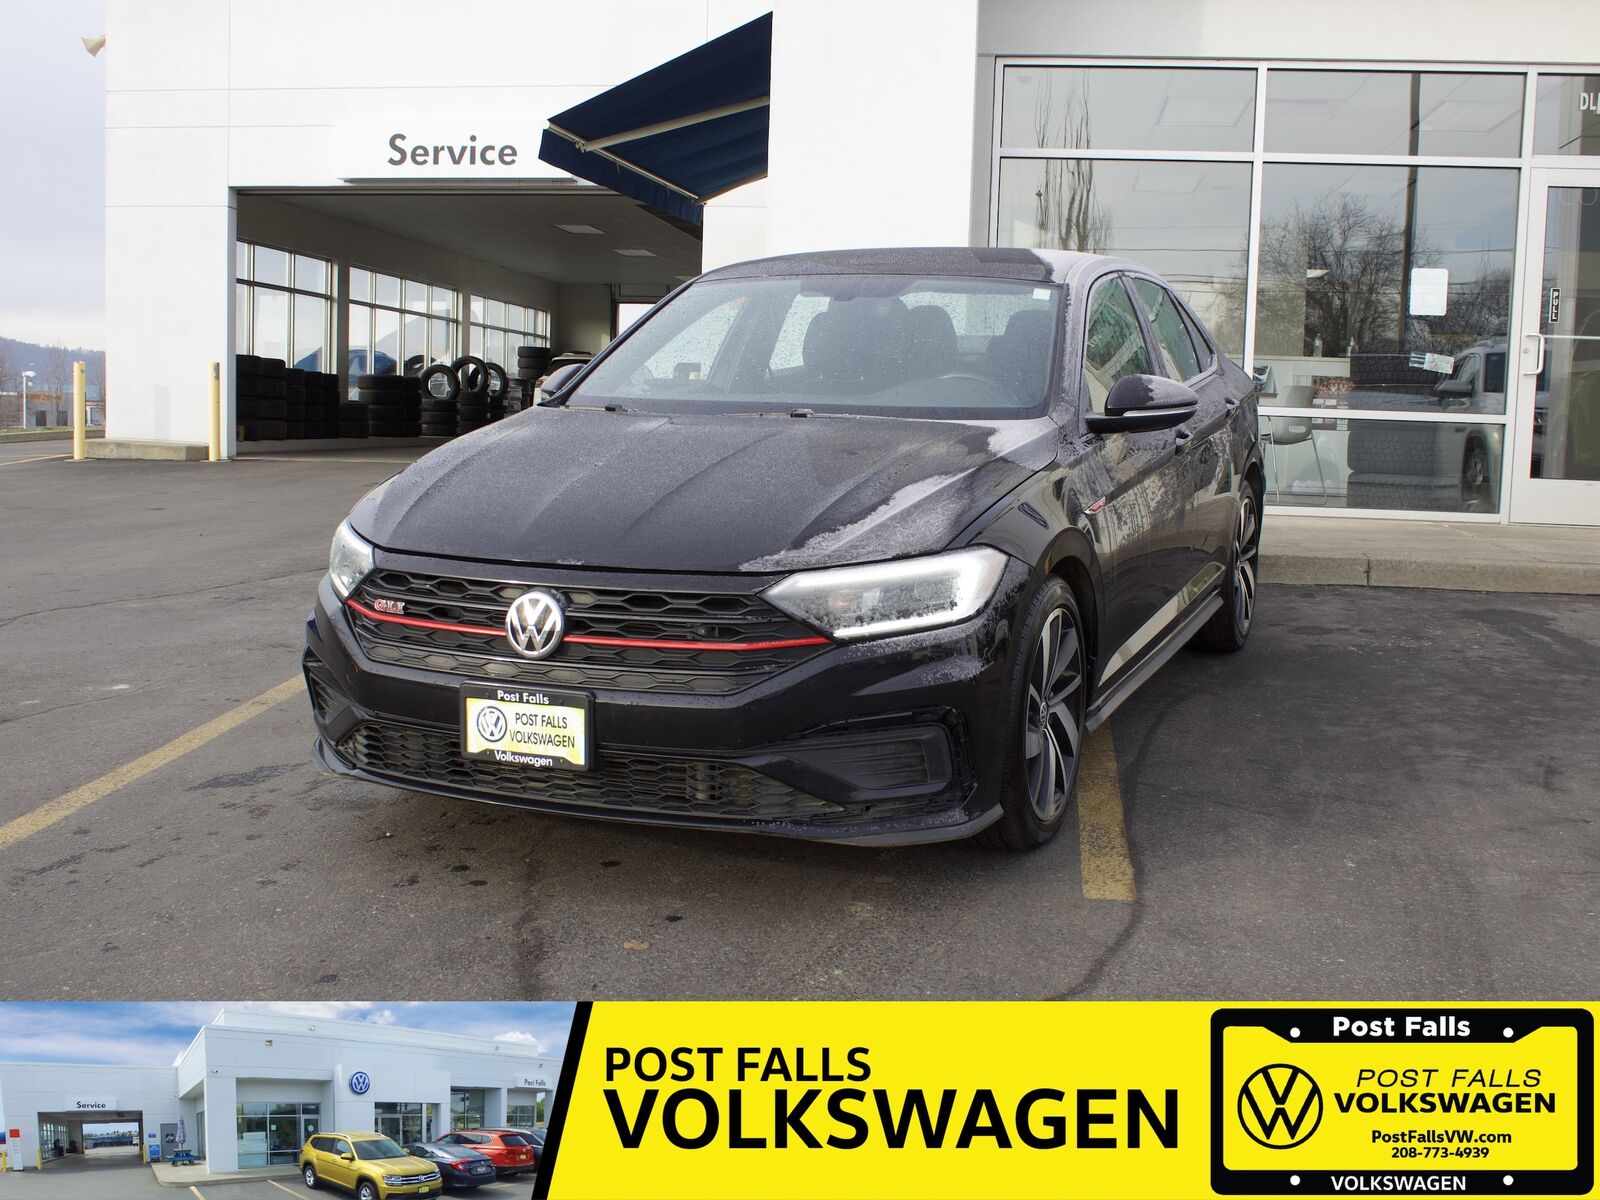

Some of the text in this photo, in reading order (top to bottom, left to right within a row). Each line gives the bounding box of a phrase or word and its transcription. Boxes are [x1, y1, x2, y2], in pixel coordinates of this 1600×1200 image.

[387, 133, 518, 166] Service
[374, 599, 405, 614] GLI
[497, 690, 549, 705] Post Falls
[515, 712, 567, 729] POST FALLS
[509, 729, 575, 748] VOLKSWAGEN
[494, 750, 553, 767] Volkswagen
